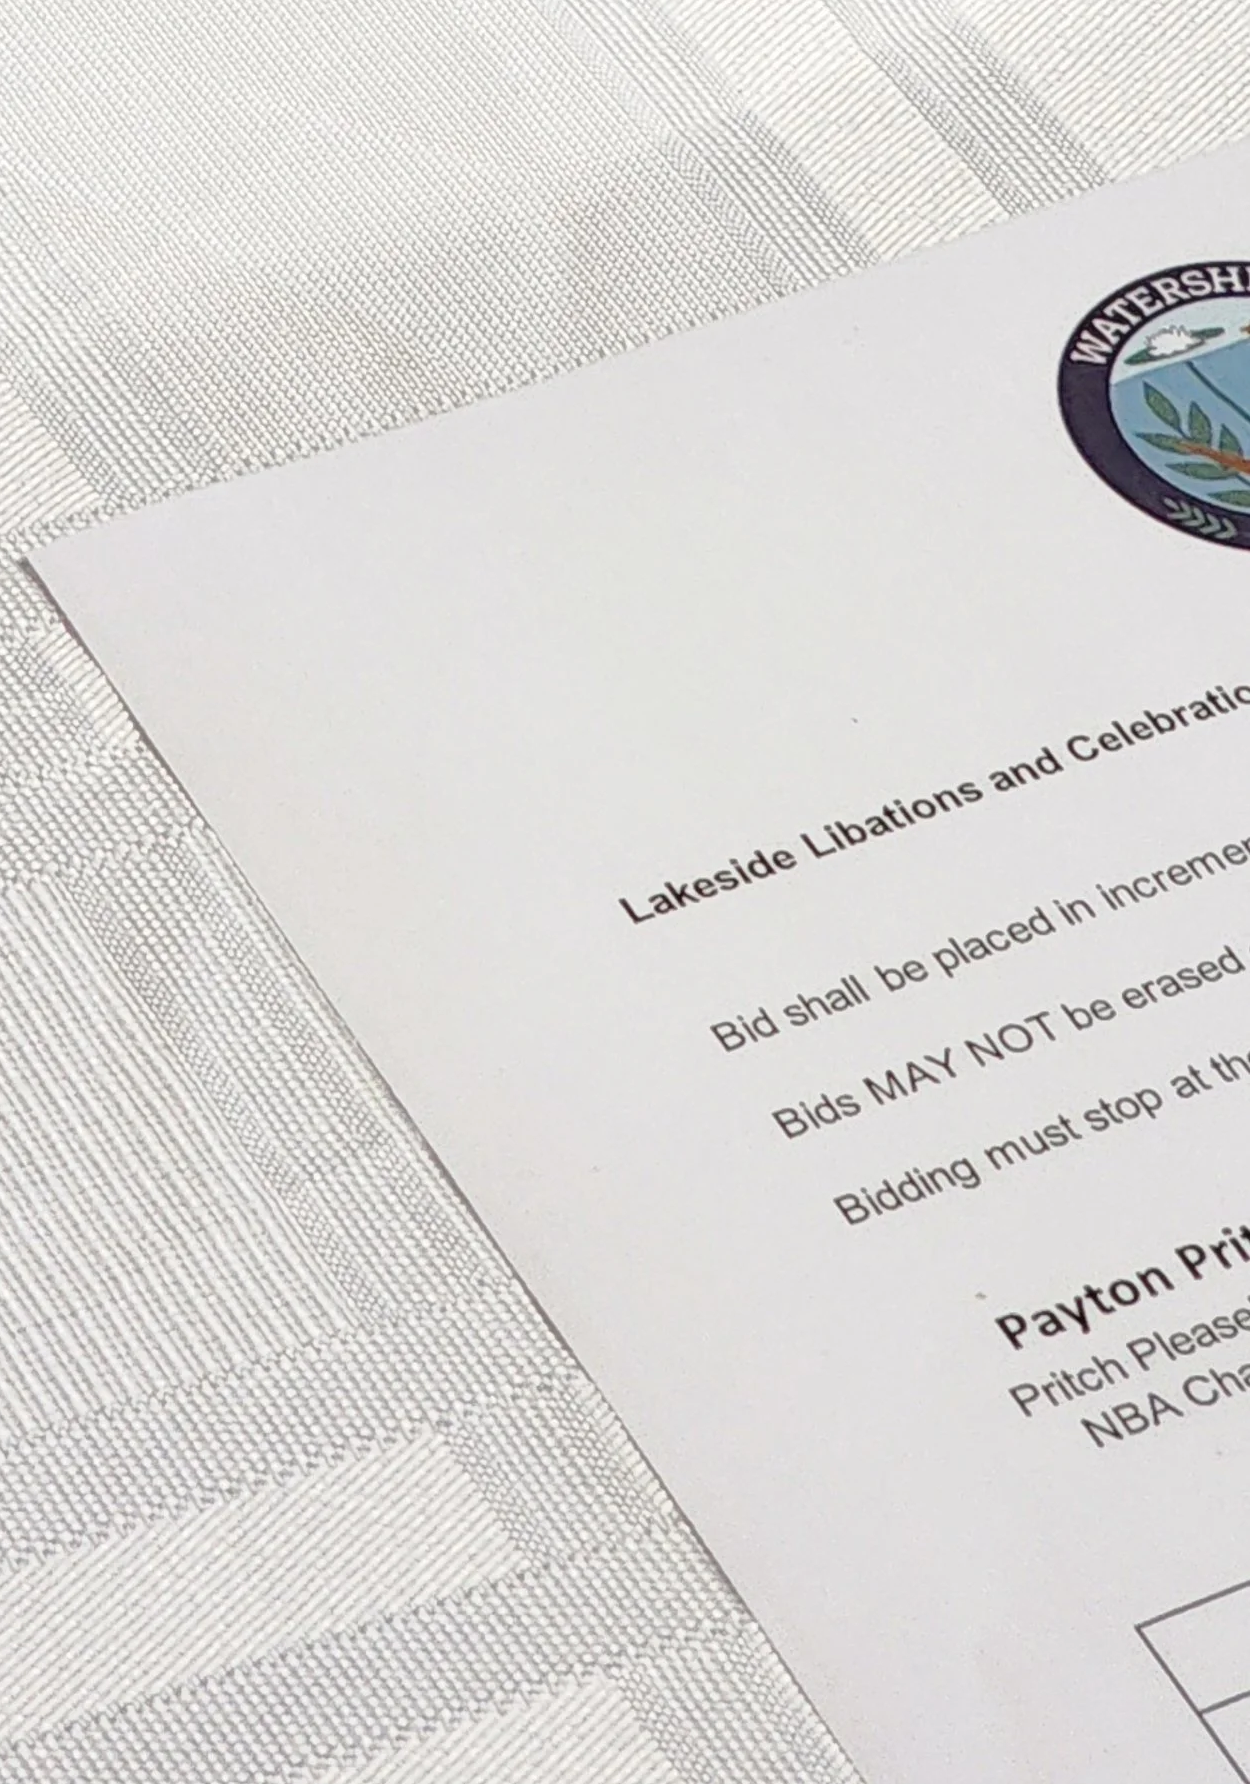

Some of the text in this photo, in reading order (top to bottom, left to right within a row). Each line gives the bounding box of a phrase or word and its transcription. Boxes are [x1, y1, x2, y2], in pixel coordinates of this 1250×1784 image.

[618, 847, 798, 925] Lakeside
[800, 779, 984, 860] Libations
[987, 746, 1065, 795] and
[710, 1008, 782, 1054] Bid
[783, 974, 872, 1031] shall
[873, 954, 931, 994] be
[932, 907, 1058, 979] placed
[1052, 895, 1097, 927] in
[771, 944, 1247, 1140] Bids MAY NOT be erased
[832, 1050, 1250, 1227] Bidding must stop at th
[994, 1265, 1176, 1352] Payton
[1007, 1295, 1250, 1418] Pritch Please
[1079, 1391, 1185, 1449] NBA
